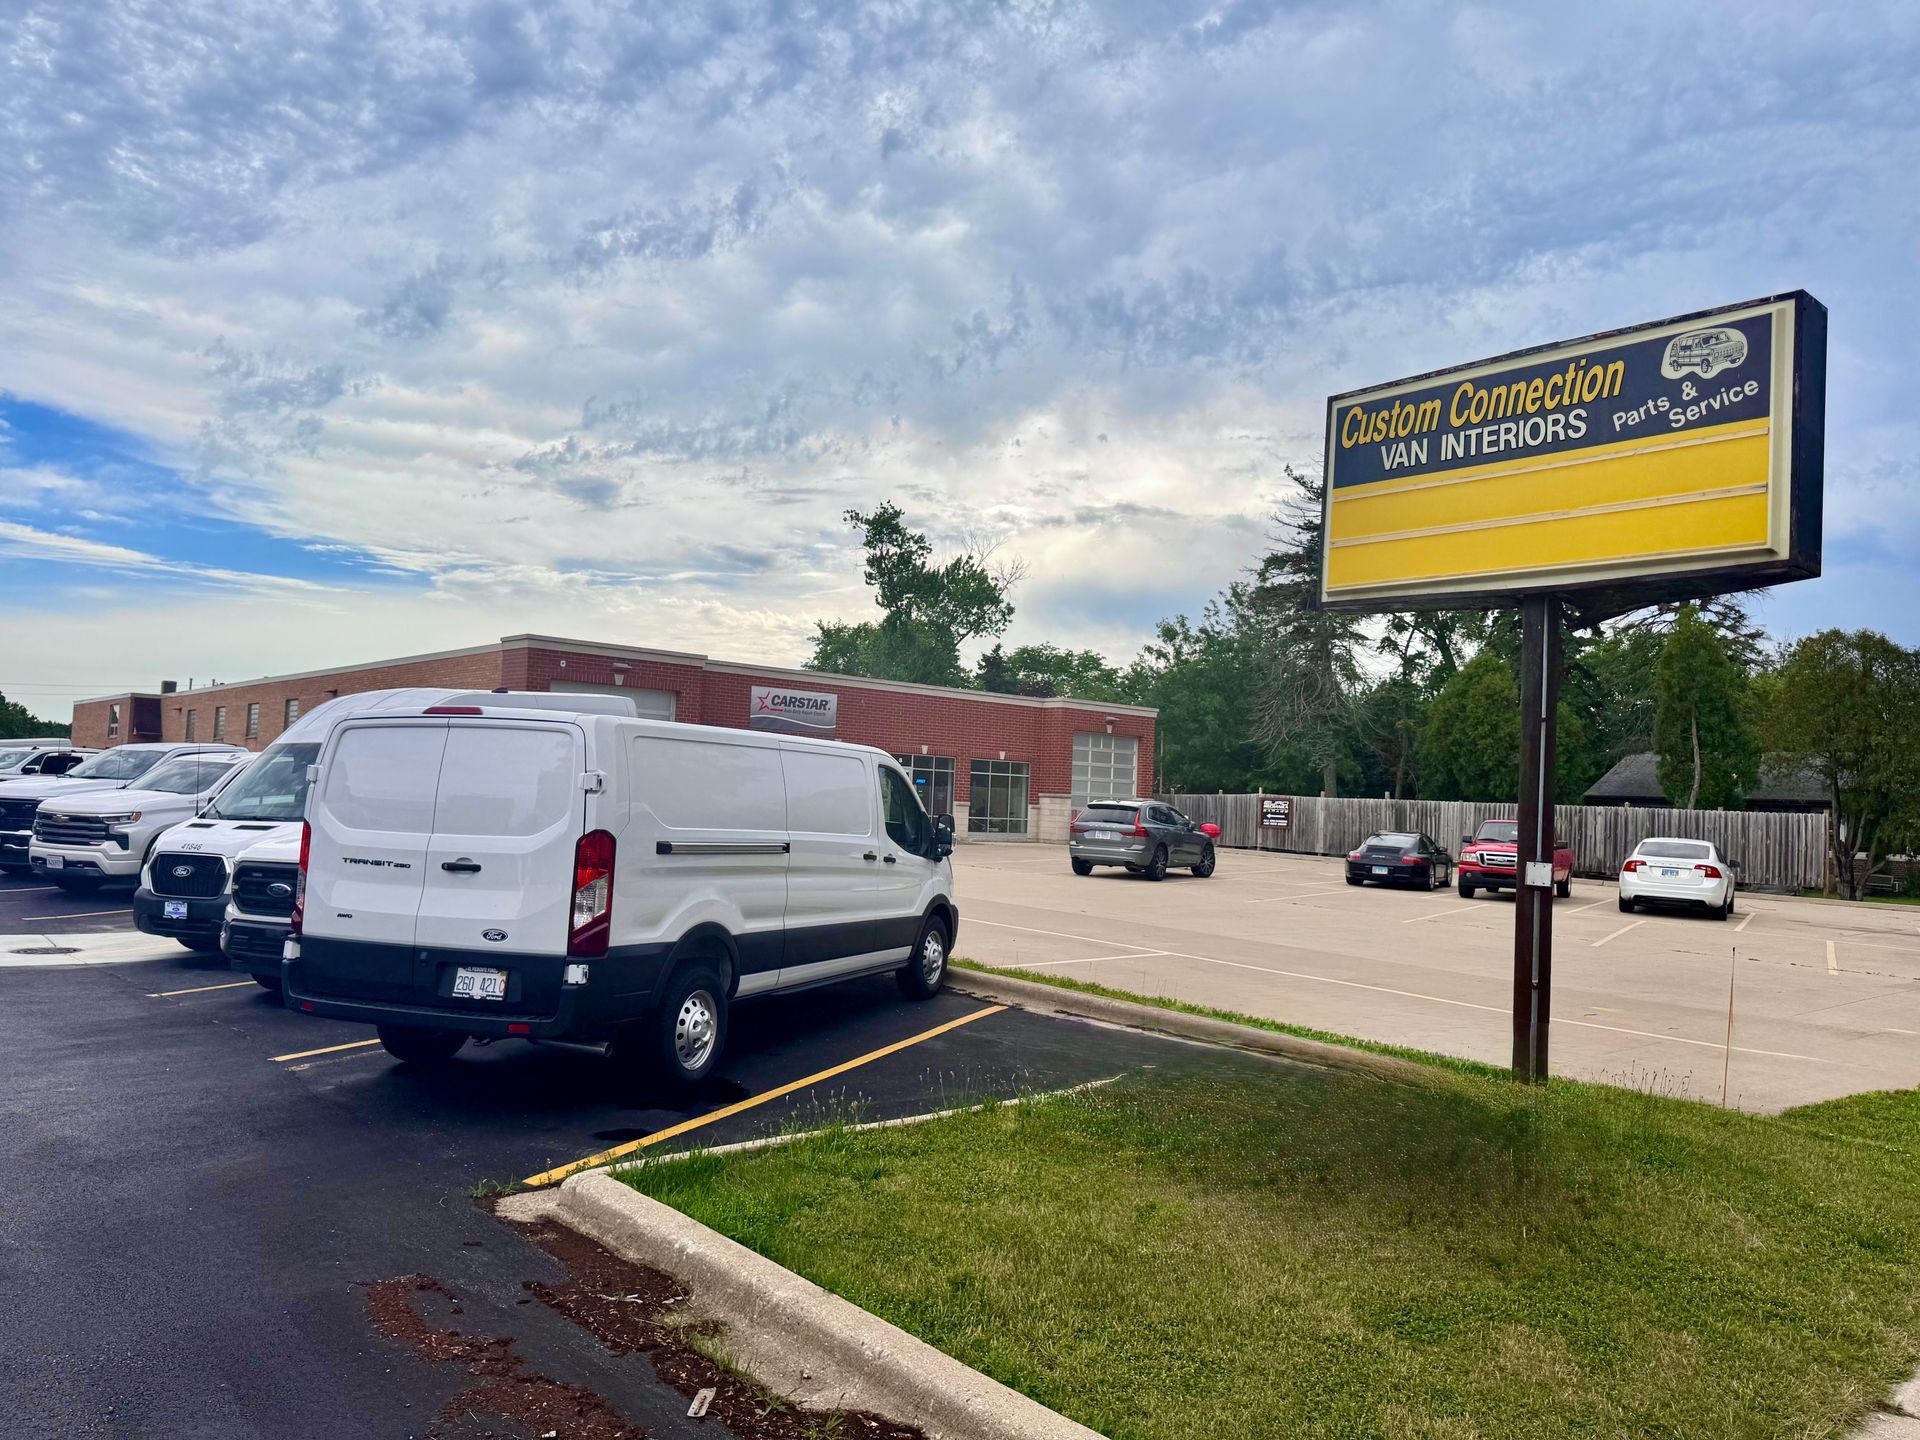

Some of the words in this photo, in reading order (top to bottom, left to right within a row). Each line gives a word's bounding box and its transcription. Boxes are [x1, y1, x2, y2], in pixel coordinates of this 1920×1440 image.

[1341, 398, 1442, 449] Custom
[1450, 359, 1625, 428] Connection
[1612, 396, 1670, 432] Parts
[1681, 381, 1699, 401] &
[1668, 380, 1760, 428] Service
[1381, 438, 1428, 471] VAN
[1440, 409, 1588, 461] INTERIORS
[771, 694, 828, 711] CARSTAR
[342, 857, 394, 867] TRANSIT
[484, 930, 505, 941] Ford
[455, 975, 476, 992] 260
